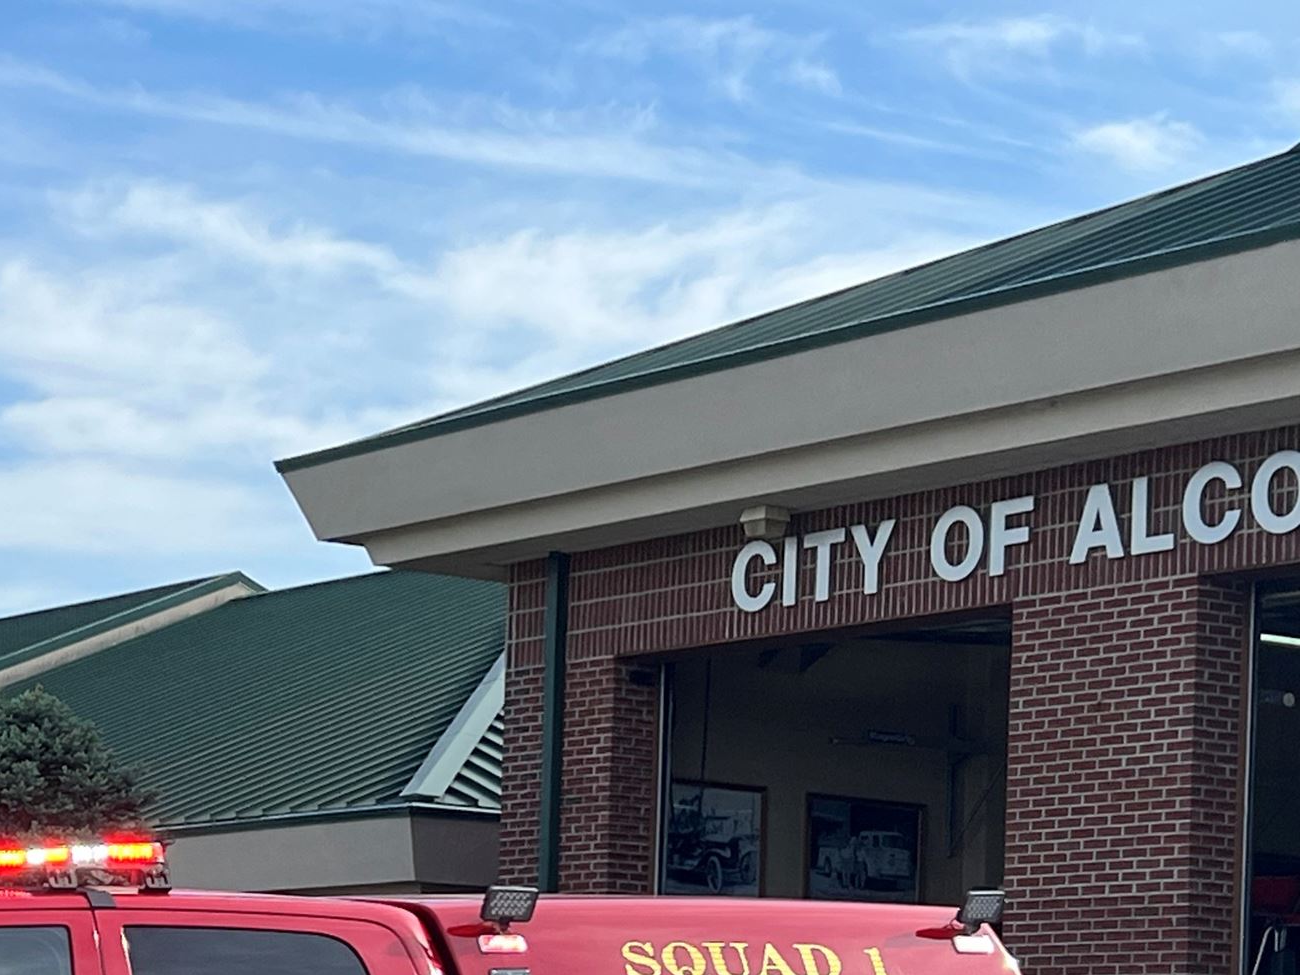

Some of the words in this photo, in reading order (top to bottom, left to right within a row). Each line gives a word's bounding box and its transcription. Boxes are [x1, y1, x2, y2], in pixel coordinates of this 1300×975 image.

[731, 518, 897, 613] CITY
[930, 494, 1035, 582] OF
[1068, 450, 1300, 565] ALCO
